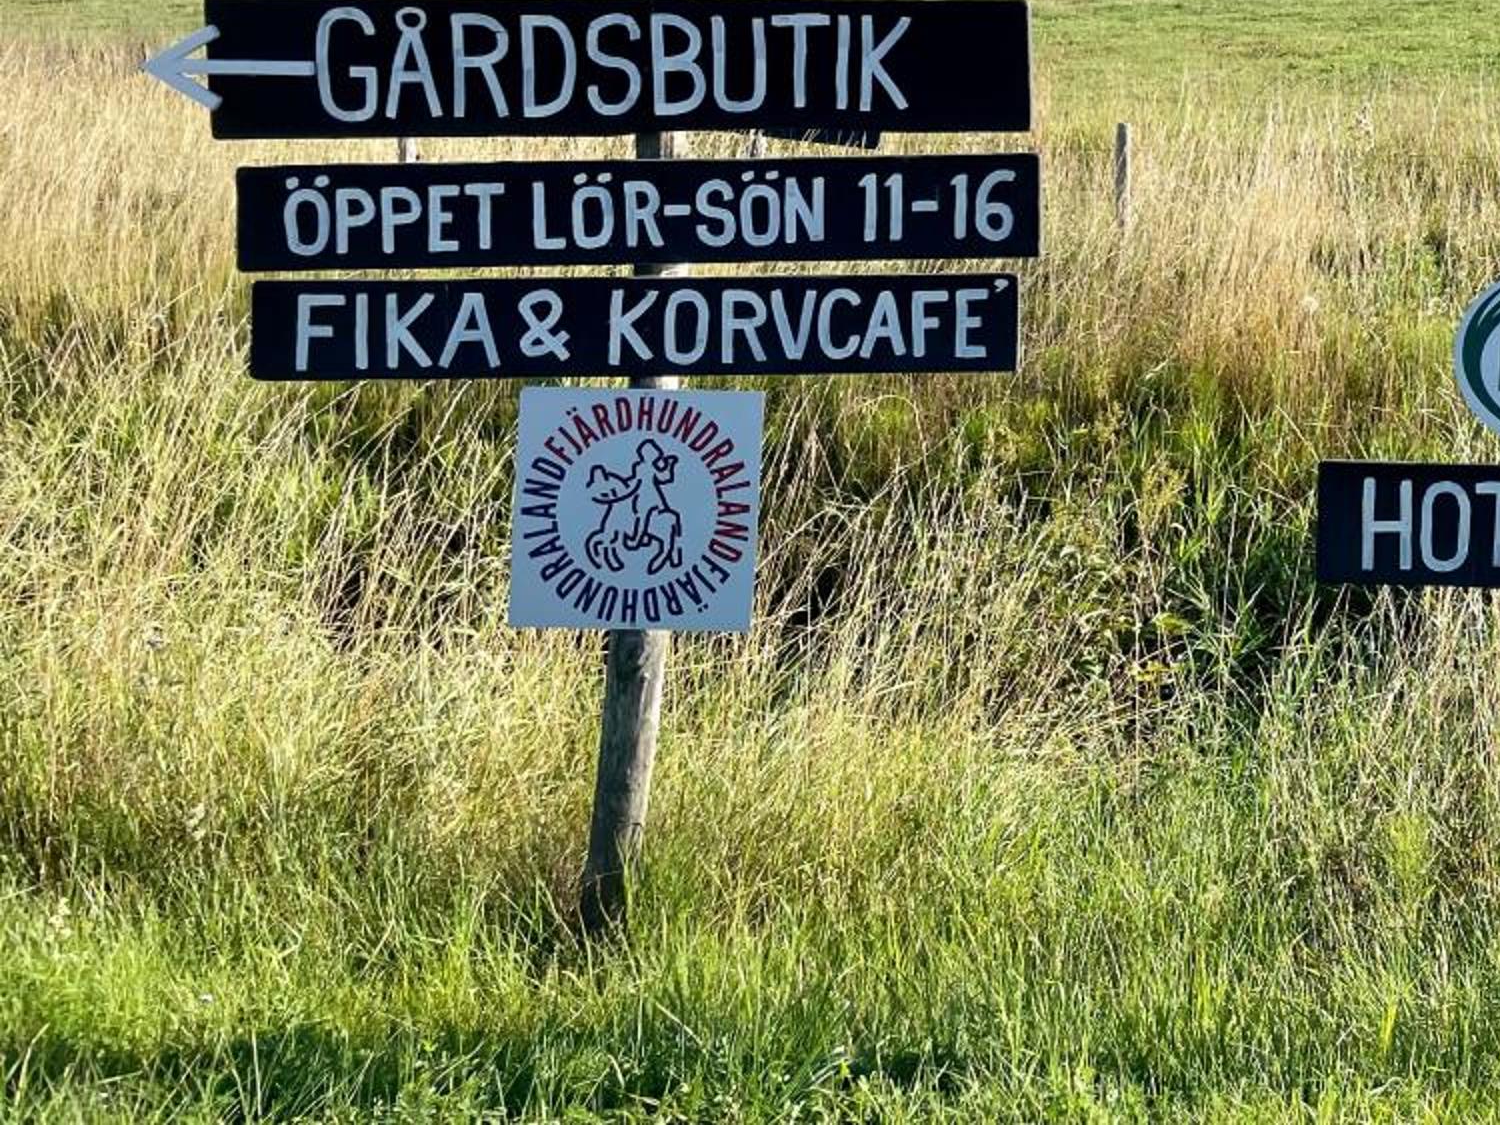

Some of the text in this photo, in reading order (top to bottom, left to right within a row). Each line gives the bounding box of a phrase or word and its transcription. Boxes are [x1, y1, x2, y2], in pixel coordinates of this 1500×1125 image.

[315, 6, 911, 124] GÅRDSBUTIK
[283, 169, 1016, 256] ÖPPET LÖR-SÖN 11-16
[294, 293, 500, 372] FIKA
[517, 289, 571, 362] &
